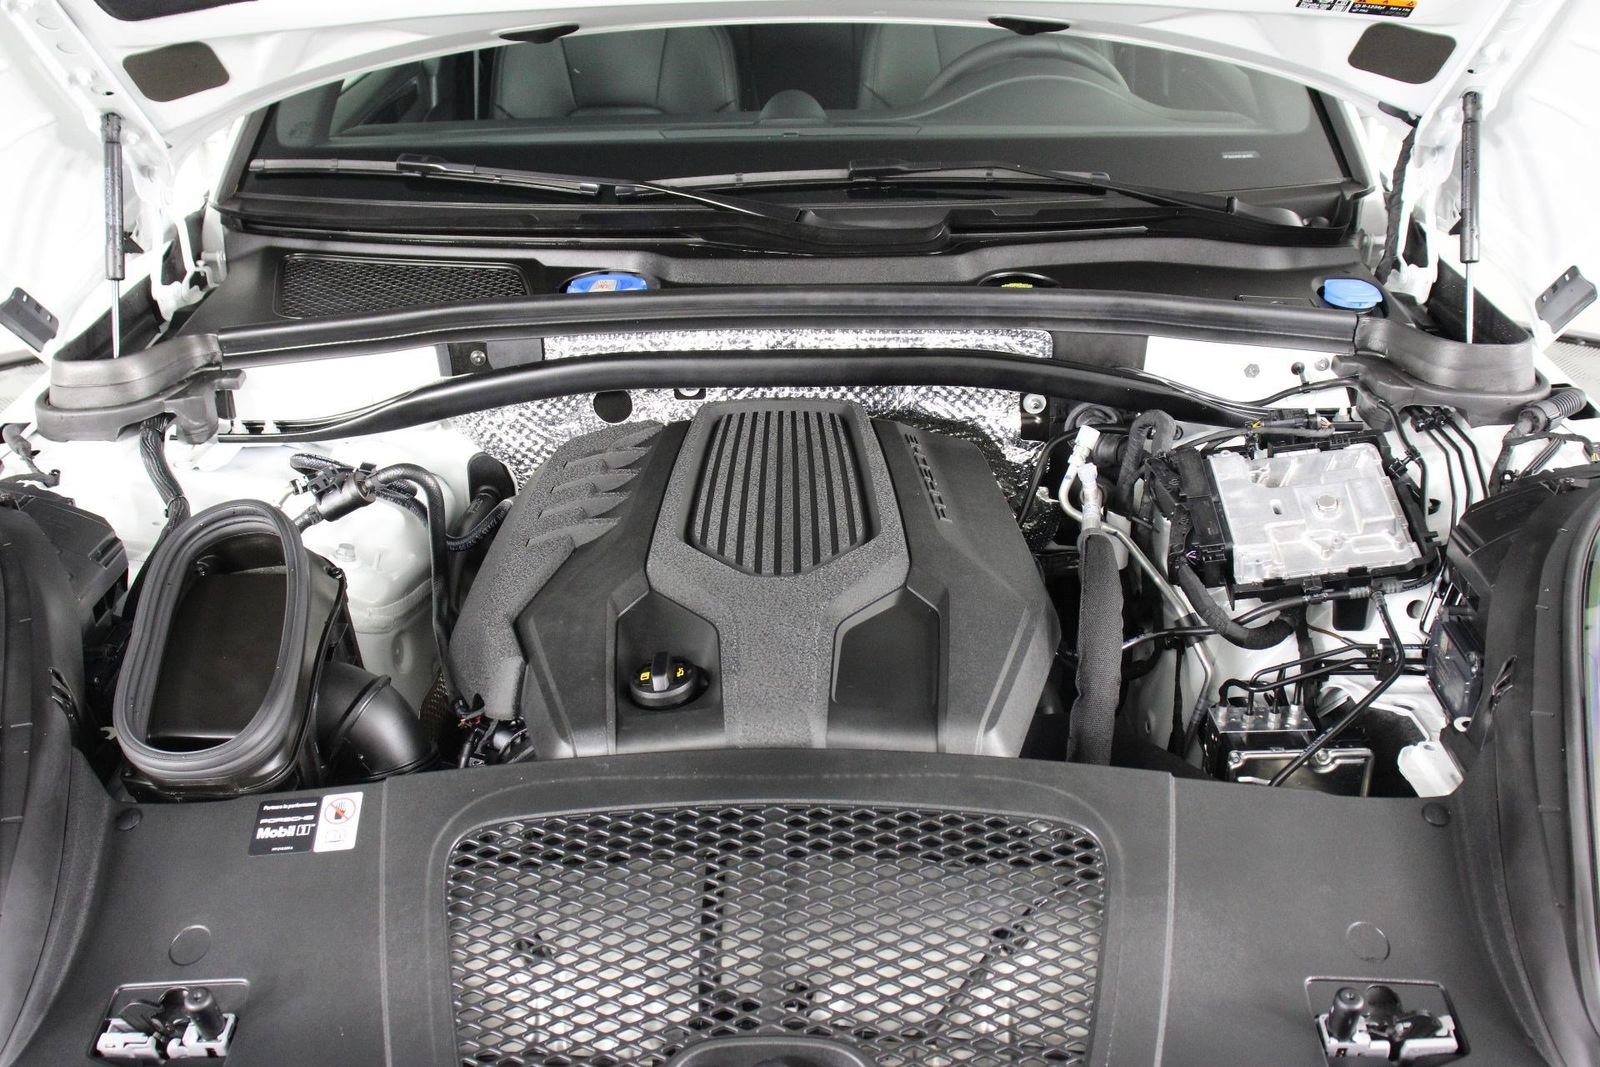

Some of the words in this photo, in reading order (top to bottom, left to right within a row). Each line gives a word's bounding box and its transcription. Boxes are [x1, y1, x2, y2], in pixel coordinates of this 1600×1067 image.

[904, 432, 953, 522] PORSCHE
[260, 814, 315, 824] PORSCHE
[256, 825, 296, 839] Mobil
